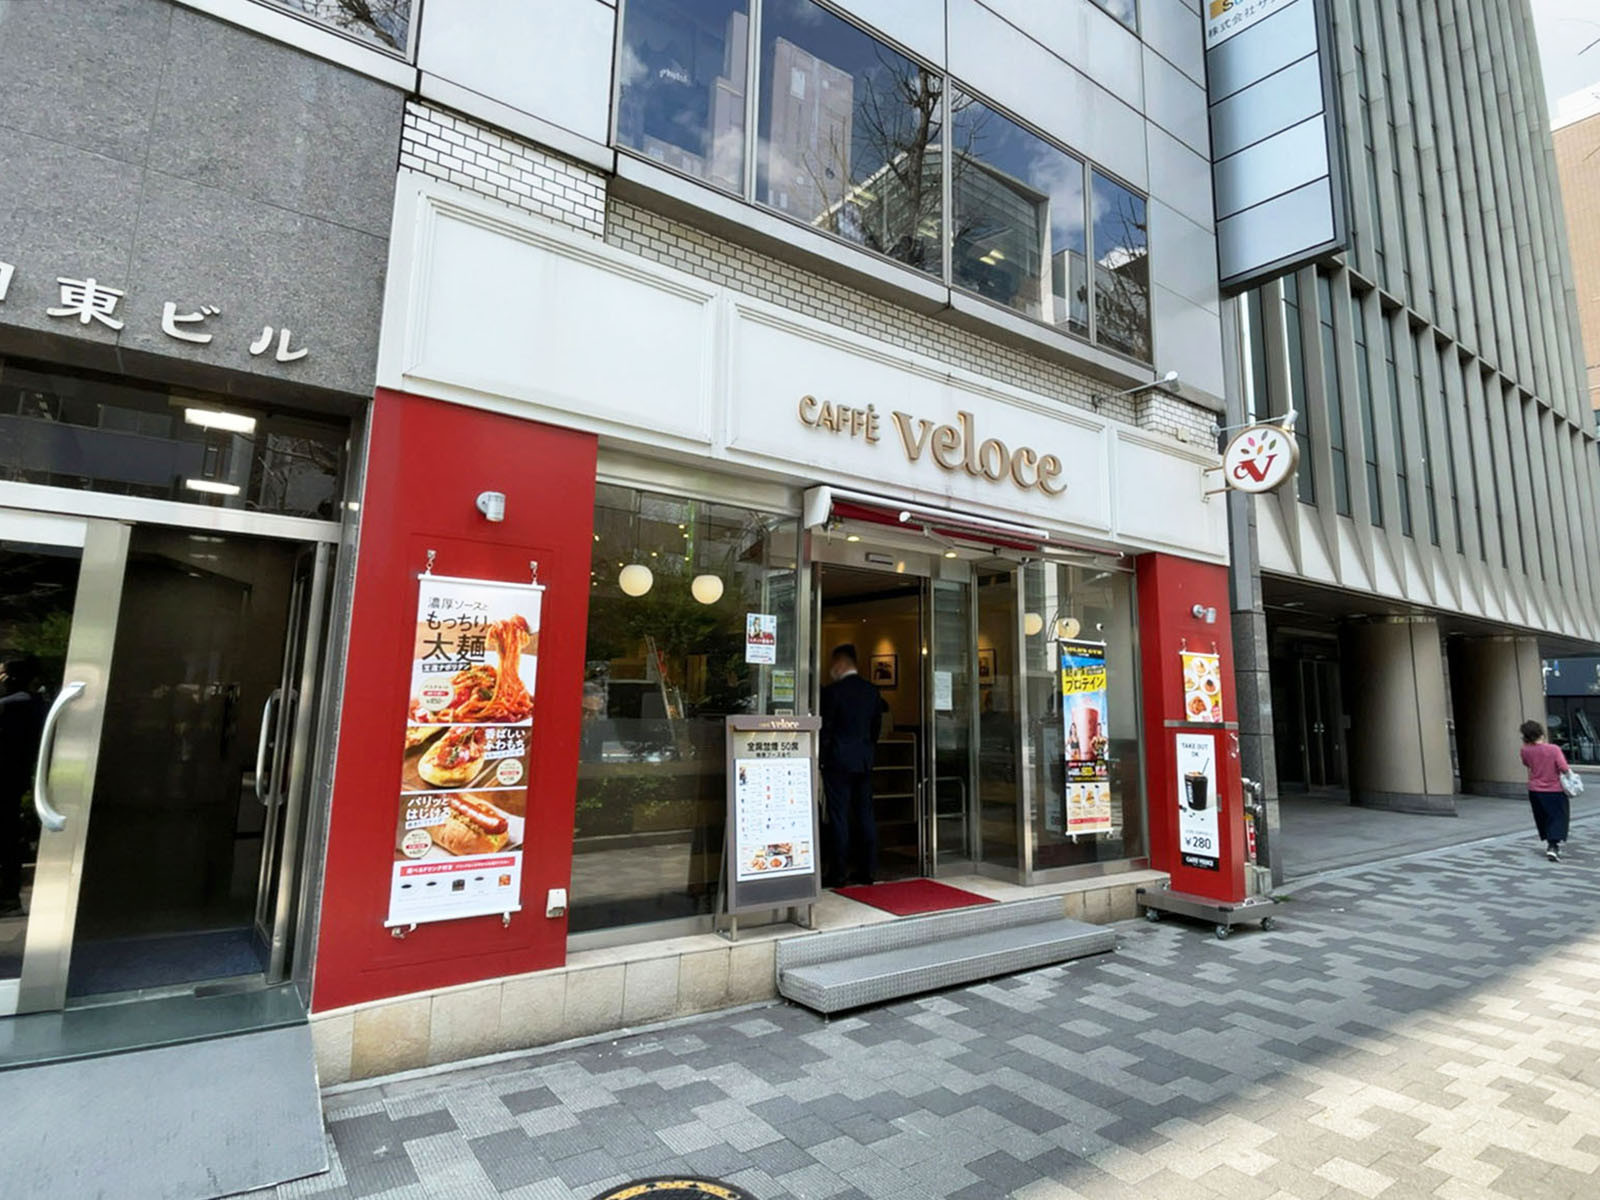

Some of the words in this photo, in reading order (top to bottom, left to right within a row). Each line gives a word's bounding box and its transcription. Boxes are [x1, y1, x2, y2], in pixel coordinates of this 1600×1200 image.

[891, 410, 1067, 497] veloce
[427, 597, 489, 611] 濃厚ソースと
[426, 611, 491, 633] もっちり
[421, 632, 487, 663] 太麺
[1065, 677, 1104, 693] プロテイン
[407, 796, 449, 808] パリッと
[406, 807, 451, 820] はじける
[1185, 836, 1212, 850] ¥280
